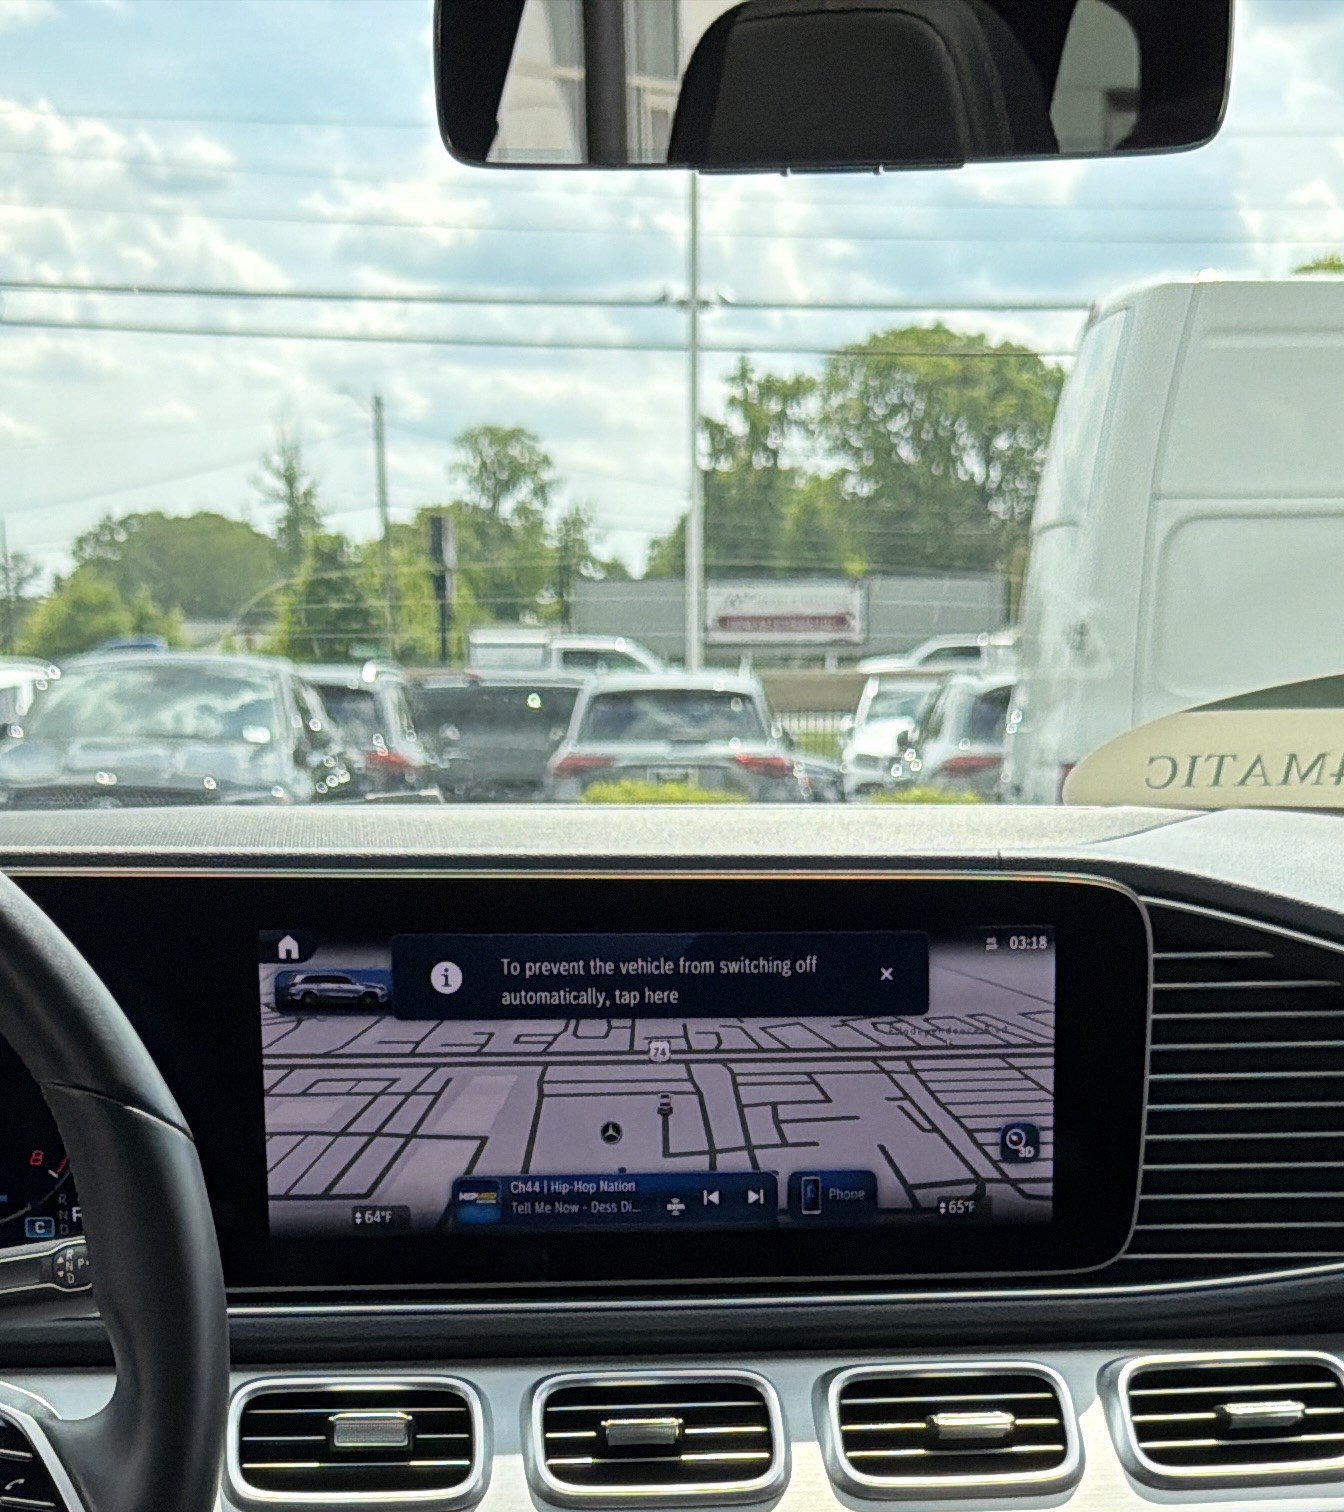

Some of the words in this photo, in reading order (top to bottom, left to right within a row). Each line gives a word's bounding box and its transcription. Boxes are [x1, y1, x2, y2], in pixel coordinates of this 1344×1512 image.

[1009, 935, 1048, 950] 03:18
[500, 958, 521, 976] To
[525, 959, 585, 979] prevent
[589, 957, 615, 975] the
[619, 956, 675, 975] vehicle
[679, 956, 715, 974] from
[719, 956, 792, 977] switching
[795, 955, 818, 973] off
[501, 987, 610, 1008] automatically,
[614, 989, 640, 1007] tap
[644, 987, 679, 1004] here
[30, 1150, 44, 1166] 8
[1018, 1146, 1035, 1158] 3D
[510, 1180, 540, 1194] Ch44
[550, 1179, 596, 1195] Hip-Hop
[599, 1179, 636, 1192] Nation
[828, 1187, 865, 1200] Phone
[511, 1201, 532, 1214] Tell
[534, 1201, 552, 1214] Me
[555, 1200, 580, 1214] Now
[590, 1200, 618, 1213] Dess
[948, 1200, 975, 1214] 65°F
[364, 1210, 393, 1224] 64°F
